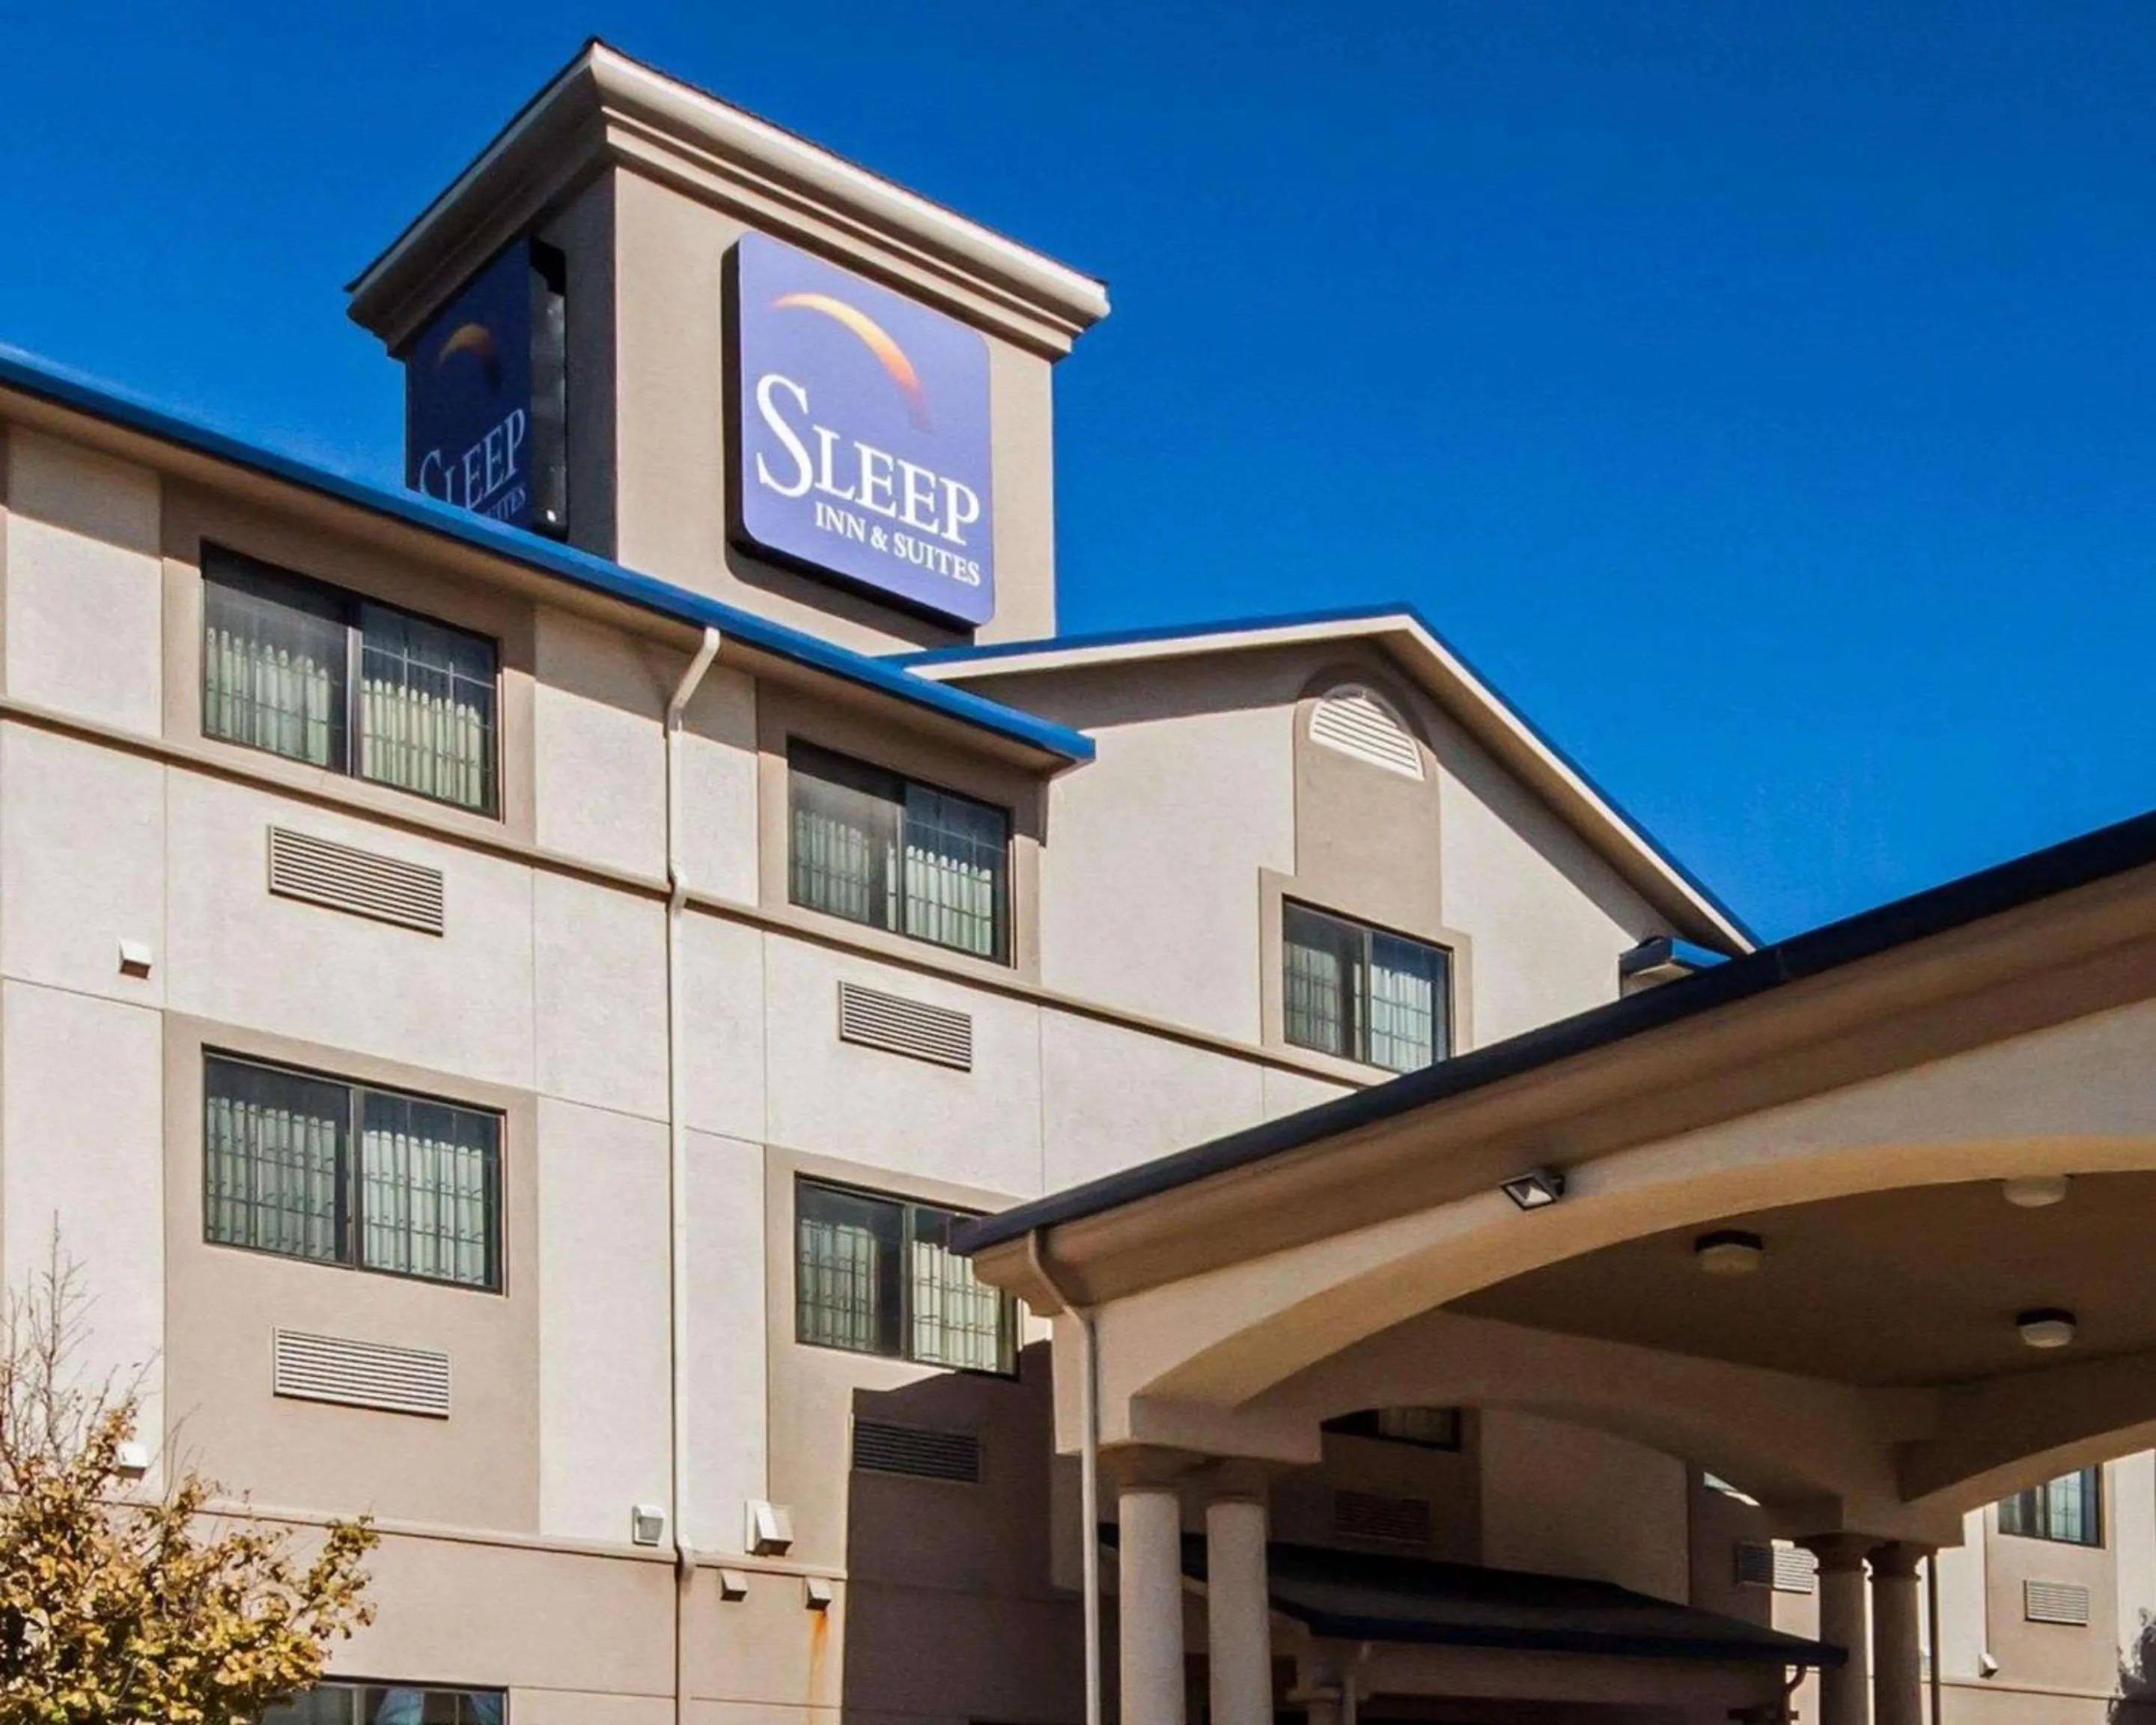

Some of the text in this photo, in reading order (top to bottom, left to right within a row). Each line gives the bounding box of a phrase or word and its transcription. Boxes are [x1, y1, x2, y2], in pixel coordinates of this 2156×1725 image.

[757, 374, 979, 545] SLEEP
[815, 502, 981, 586] INN & SUITES
